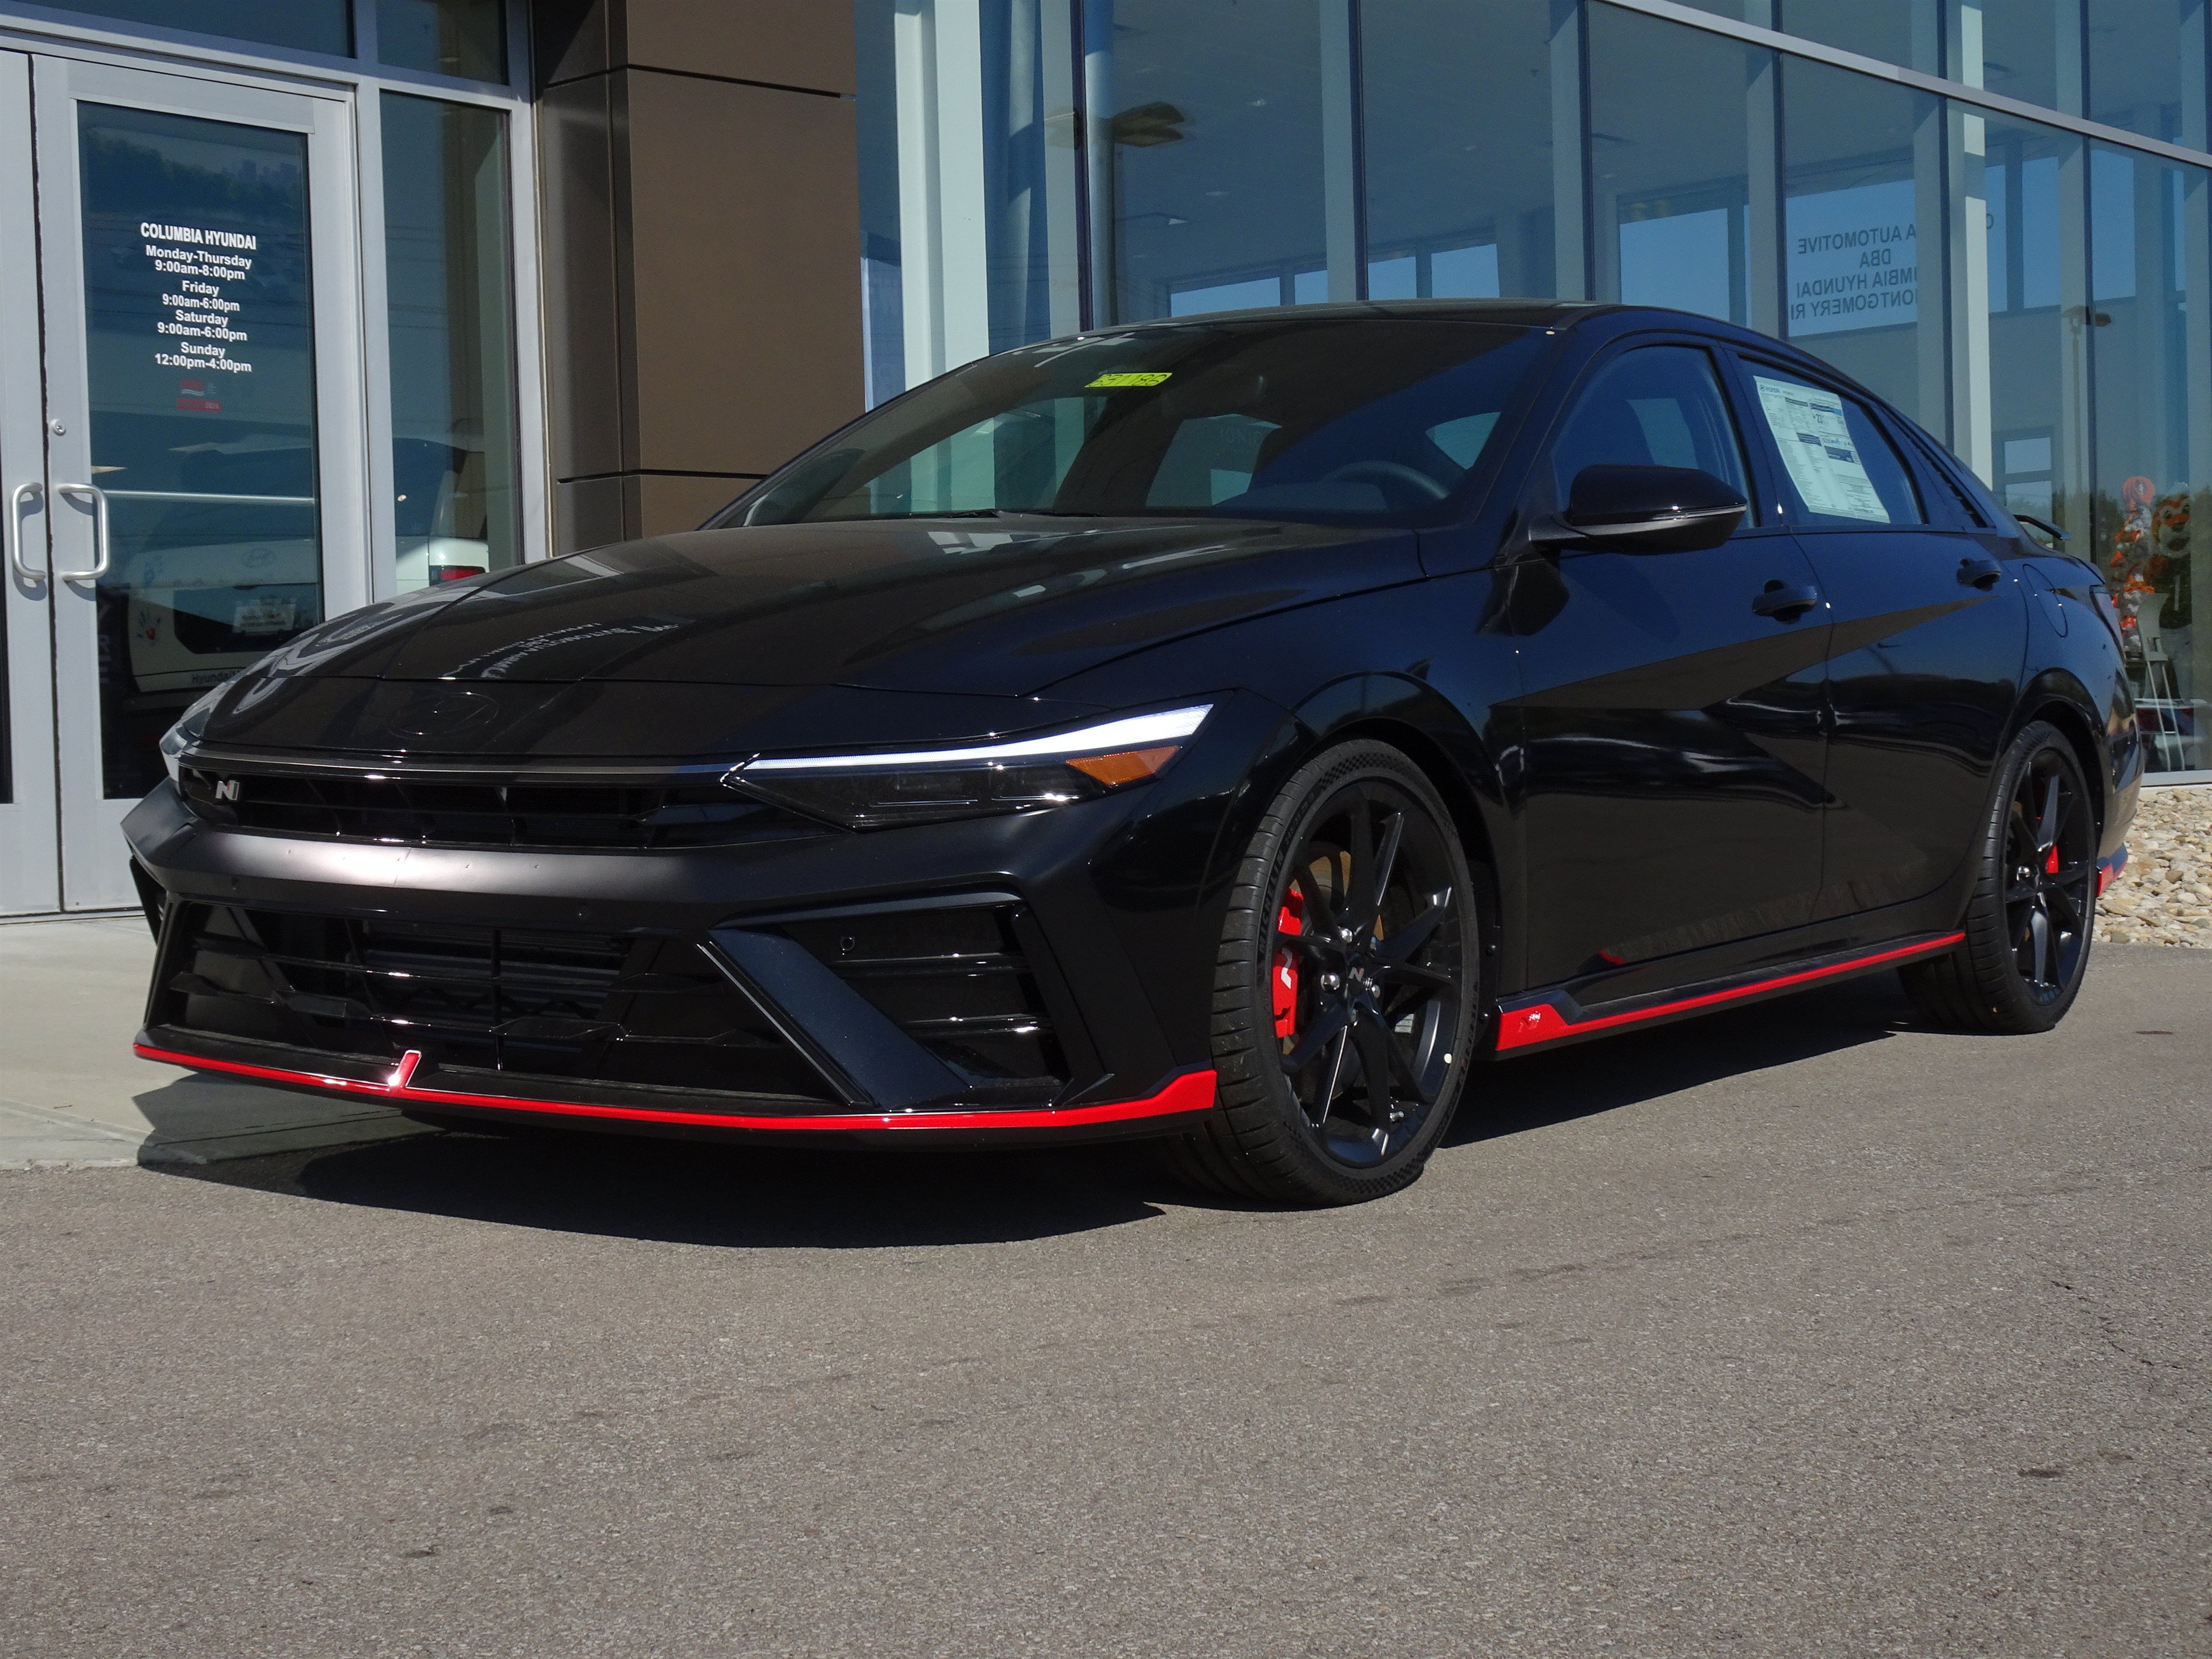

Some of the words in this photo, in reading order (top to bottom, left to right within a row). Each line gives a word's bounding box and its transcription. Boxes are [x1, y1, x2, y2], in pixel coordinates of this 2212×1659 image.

[140, 222, 204, 244] COLUMBIA
[205, 230, 257, 250] HYUNDAI
[146, 245, 252, 269] Monday-Thursday
[155, 260, 245, 281] 9:00am-8:00pm
[182, 280, 219, 296] Friday
[162, 293, 240, 313] 9:00am-6:00pm
[175, 309, 228, 327] Saturday
[157, 322, 247, 342] 9:00am-6:00pm
[180, 341, 225, 359] Sunday
[155, 353, 252, 373] 12:00pm-4:00pm
[215, 780, 240, 800] N
[1348, 966, 1365, 982] N
